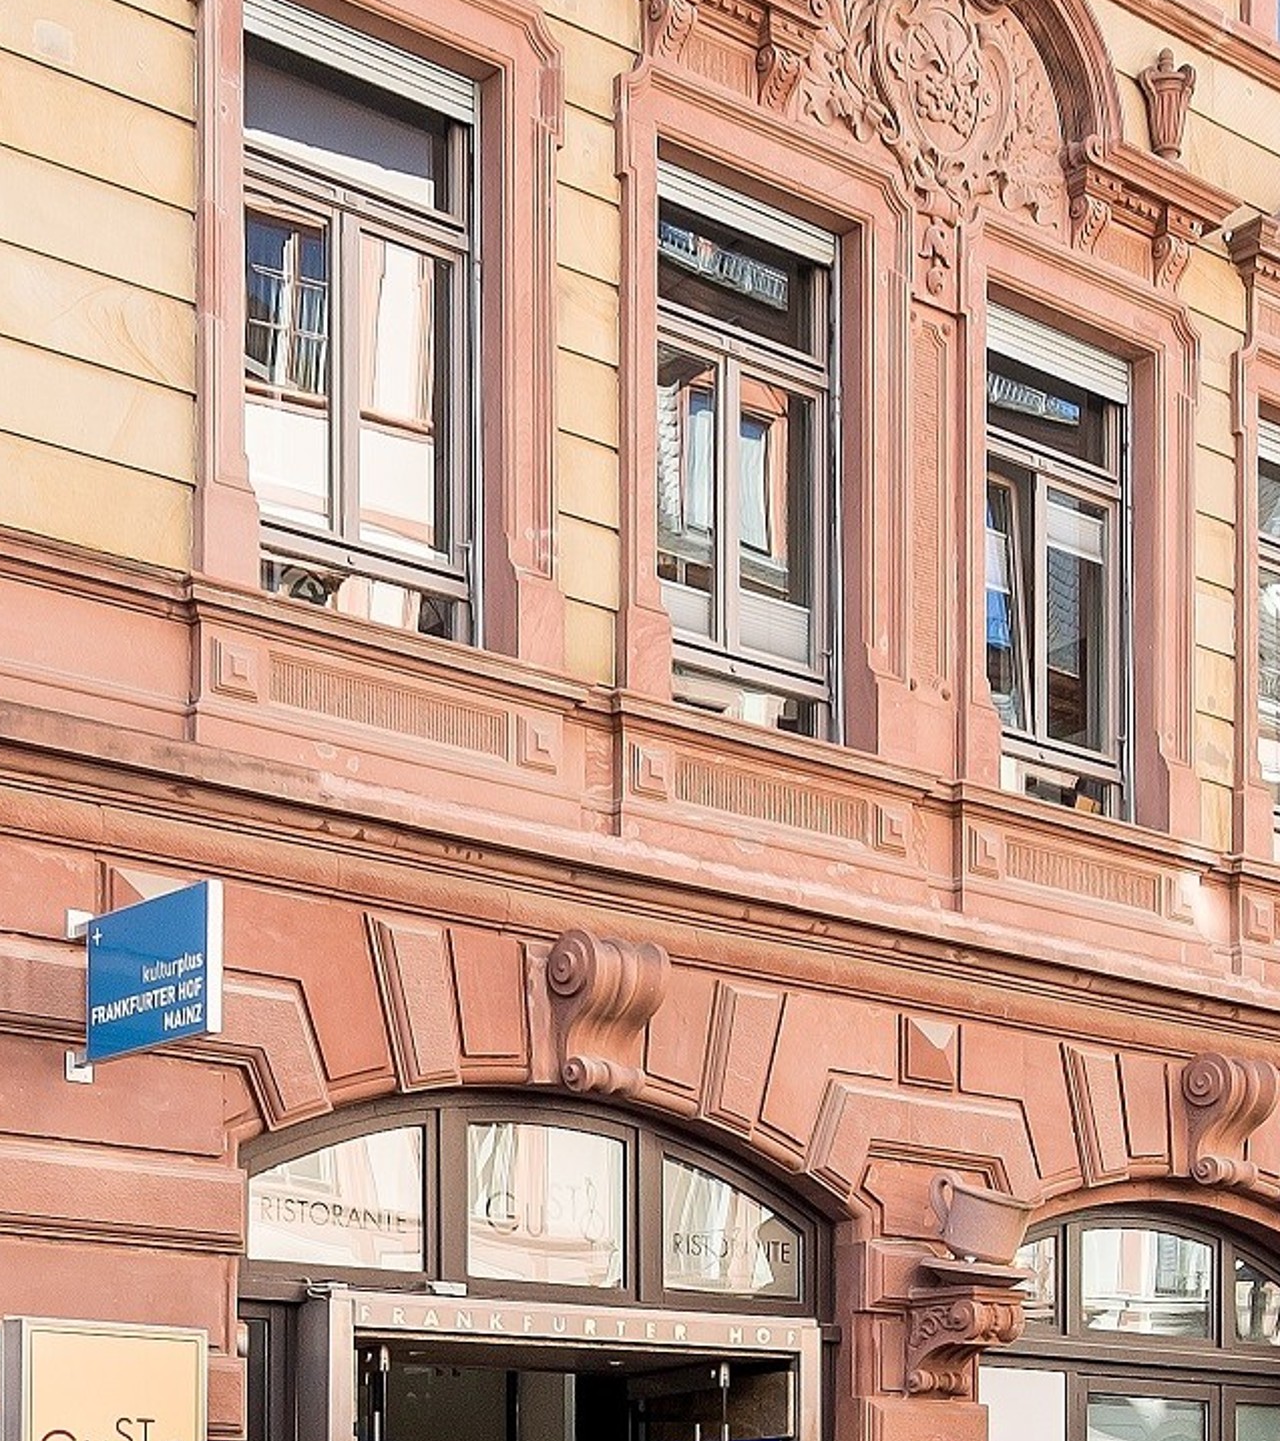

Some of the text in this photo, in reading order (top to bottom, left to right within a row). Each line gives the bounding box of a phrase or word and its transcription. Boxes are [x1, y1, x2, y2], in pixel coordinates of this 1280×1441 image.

[142, 952, 203, 983] kulturplus
[92, 976, 204, 1026] FRANKFURTER HOF
[164, 1003, 203, 1031] MAINZ
[260, 1195, 408, 1234] RISTORANTE
[673, 1232, 791, 1264] RISTONTE
[360, 1305, 797, 1346] FRANKFURTER HOF
